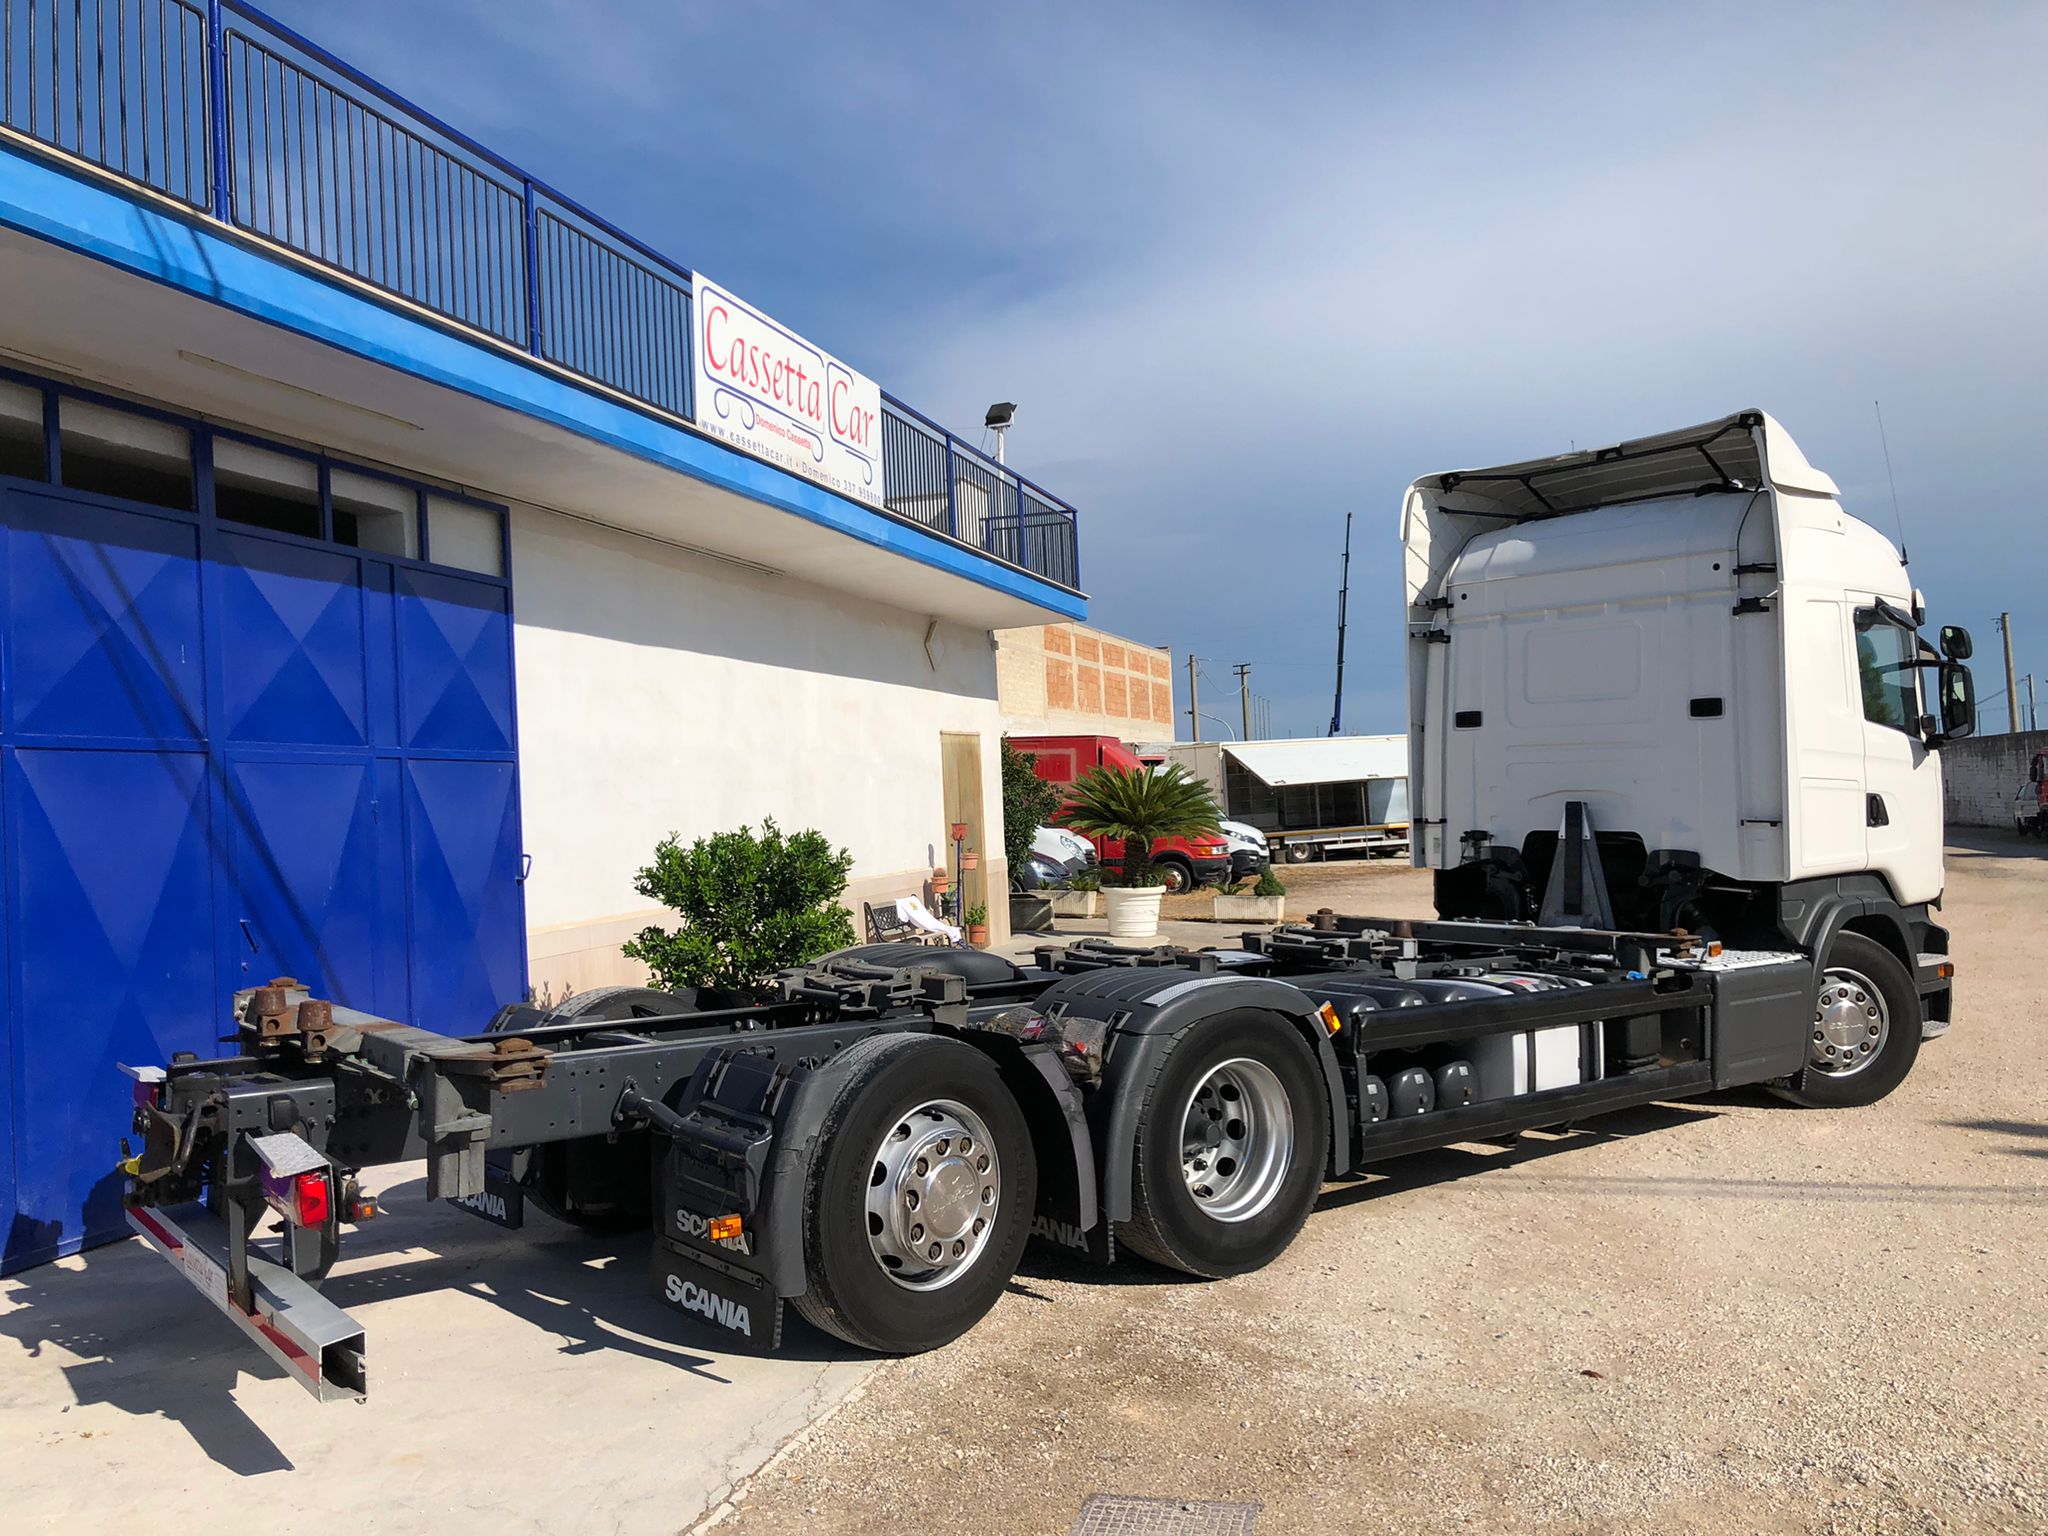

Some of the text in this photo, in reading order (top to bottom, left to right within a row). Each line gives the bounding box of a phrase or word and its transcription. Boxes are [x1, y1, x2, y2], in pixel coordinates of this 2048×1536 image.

[706, 305, 875, 448] Cassetta Car
[701, 419, 793, 468] www.cassettacar.it
[801, 461, 841, 489] Domenico
[755, 413, 786, 438] Domenico
[456, 1191, 507, 1221] CANIA
[664, 1272, 752, 1337] SCANIA
